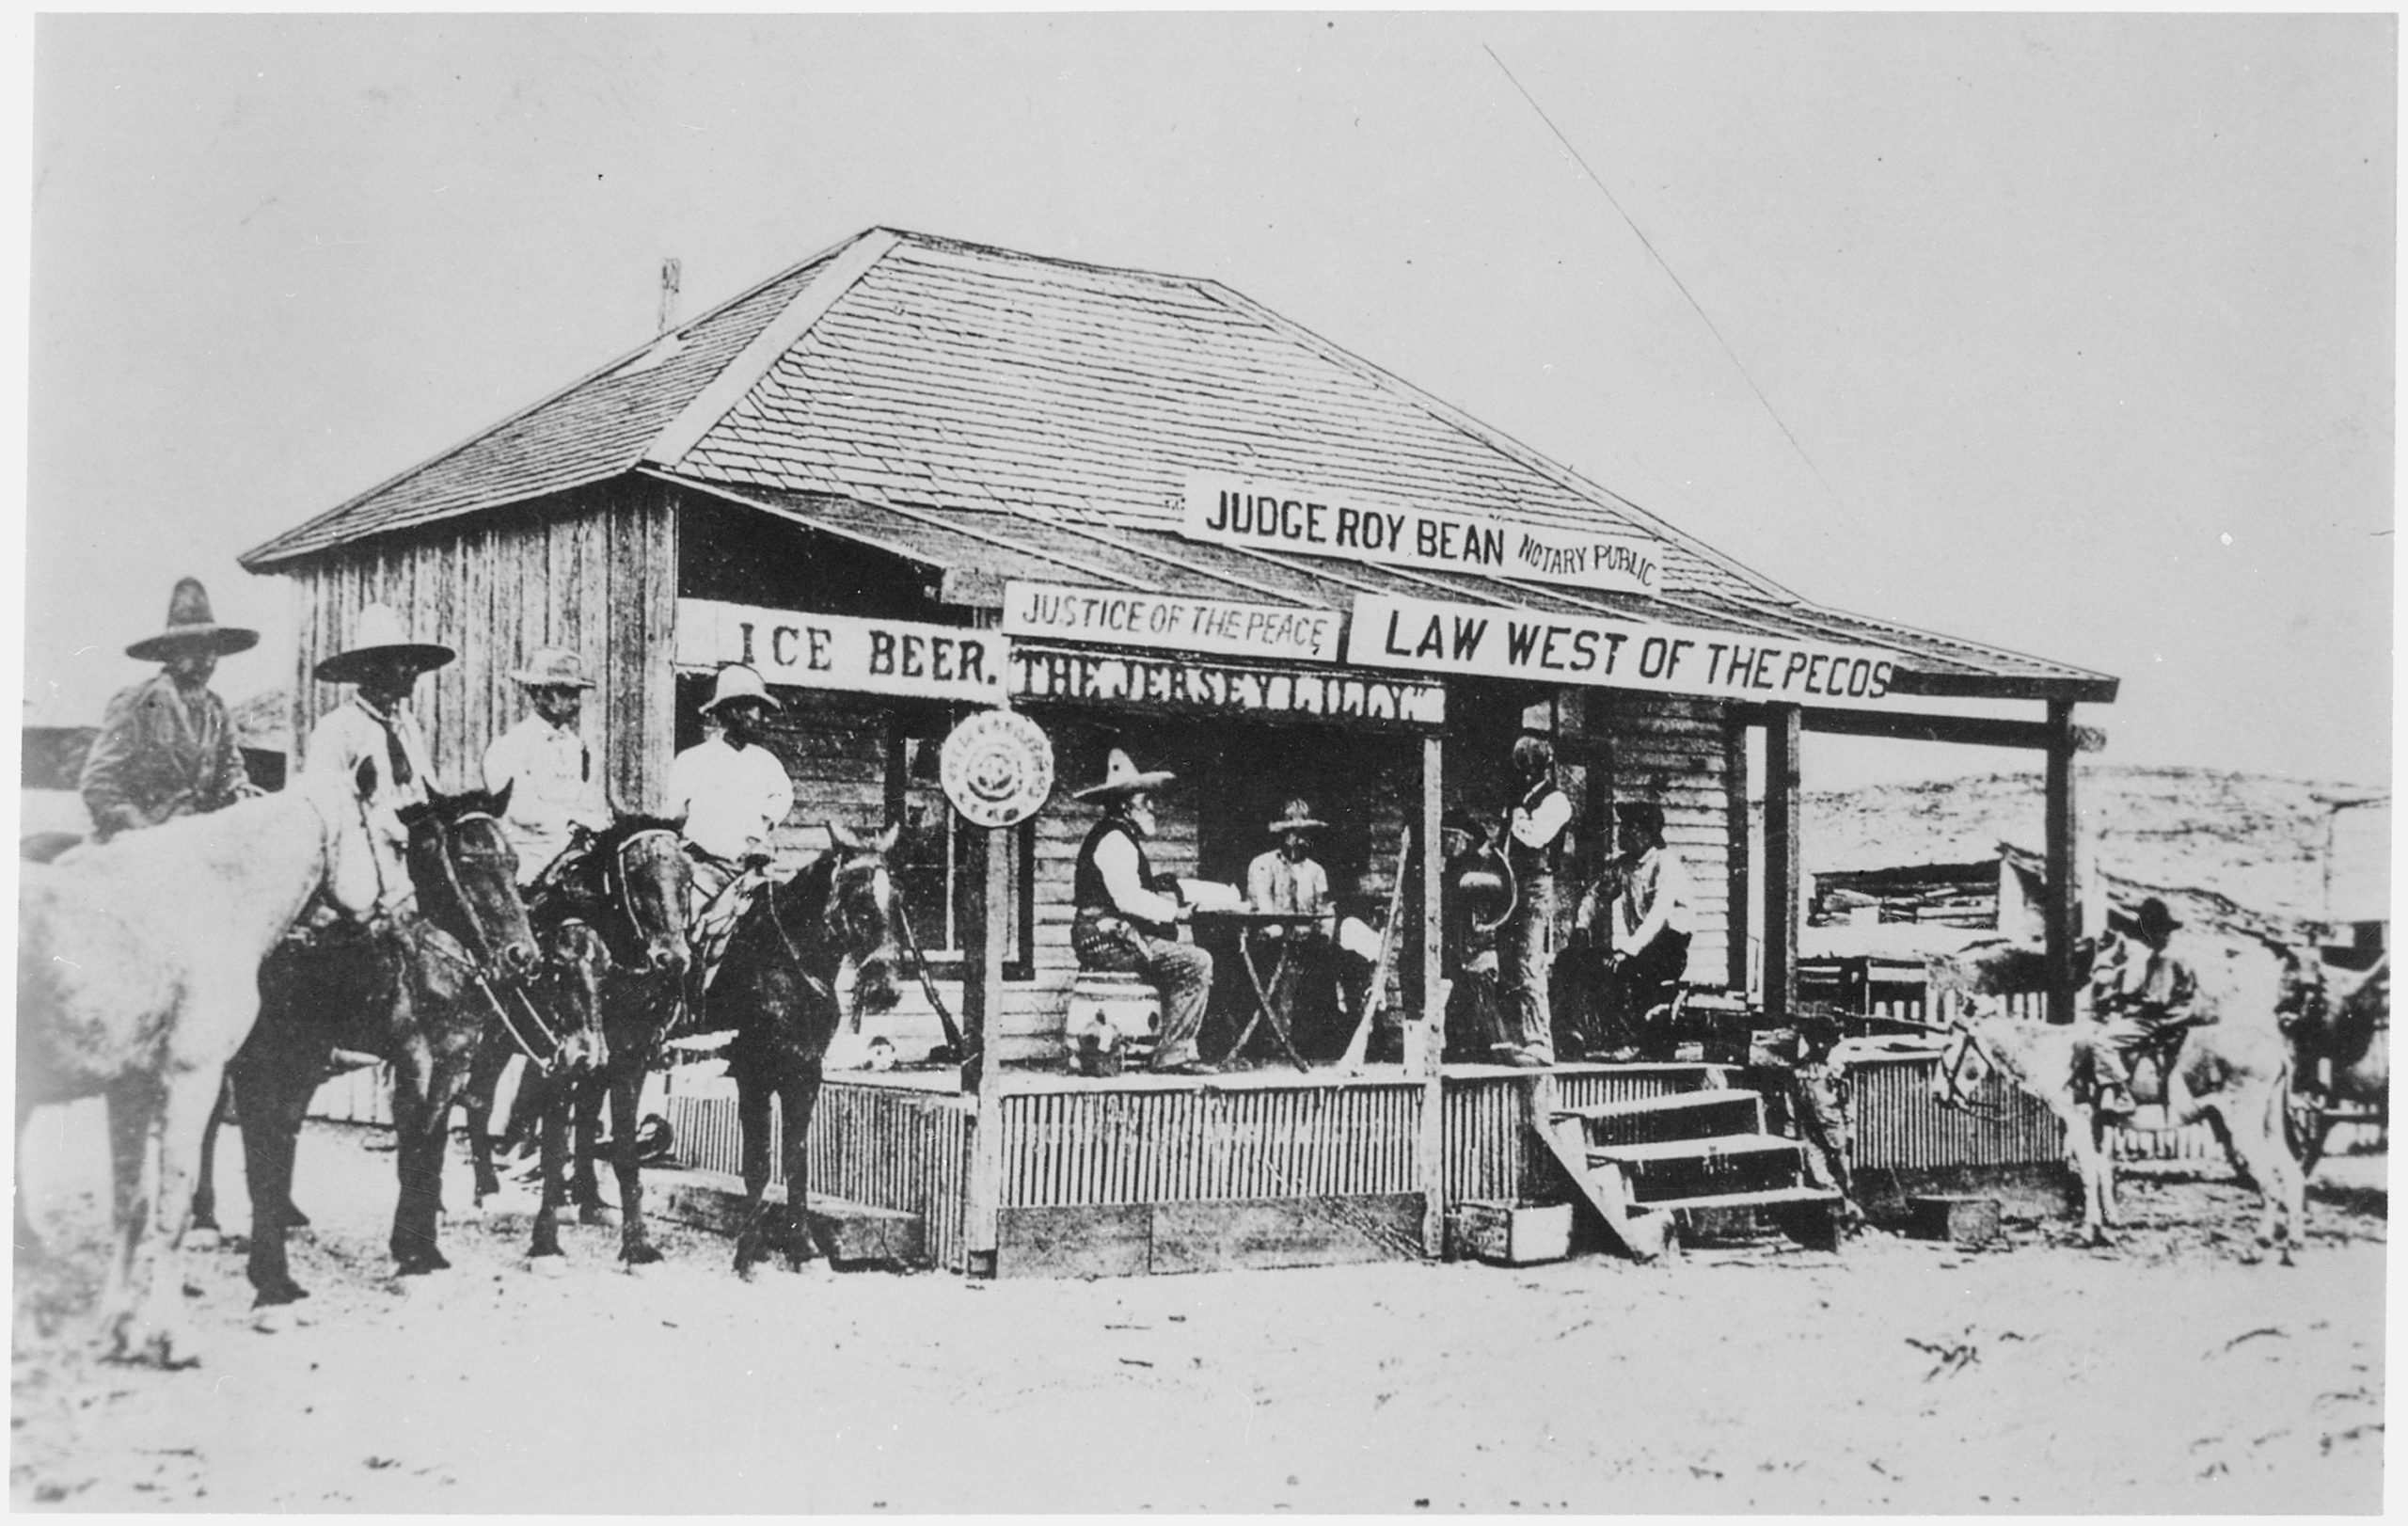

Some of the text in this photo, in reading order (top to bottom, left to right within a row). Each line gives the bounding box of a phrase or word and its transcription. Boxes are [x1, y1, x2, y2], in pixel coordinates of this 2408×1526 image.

[1206, 490, 1656, 587] JUDGE ROY BEAN NOTARY PUBLIC
[1022, 592, 1146, 632] JUSTICE
[1149, 604, 1183, 635] OF
[1191, 607, 1244, 639] THE
[739, 622, 998, 685] ICE BEER.
[1110, 657, 1269, 712] JERSEY
[1385, 610, 1892, 699] LAW WEST OF THE PECOS
